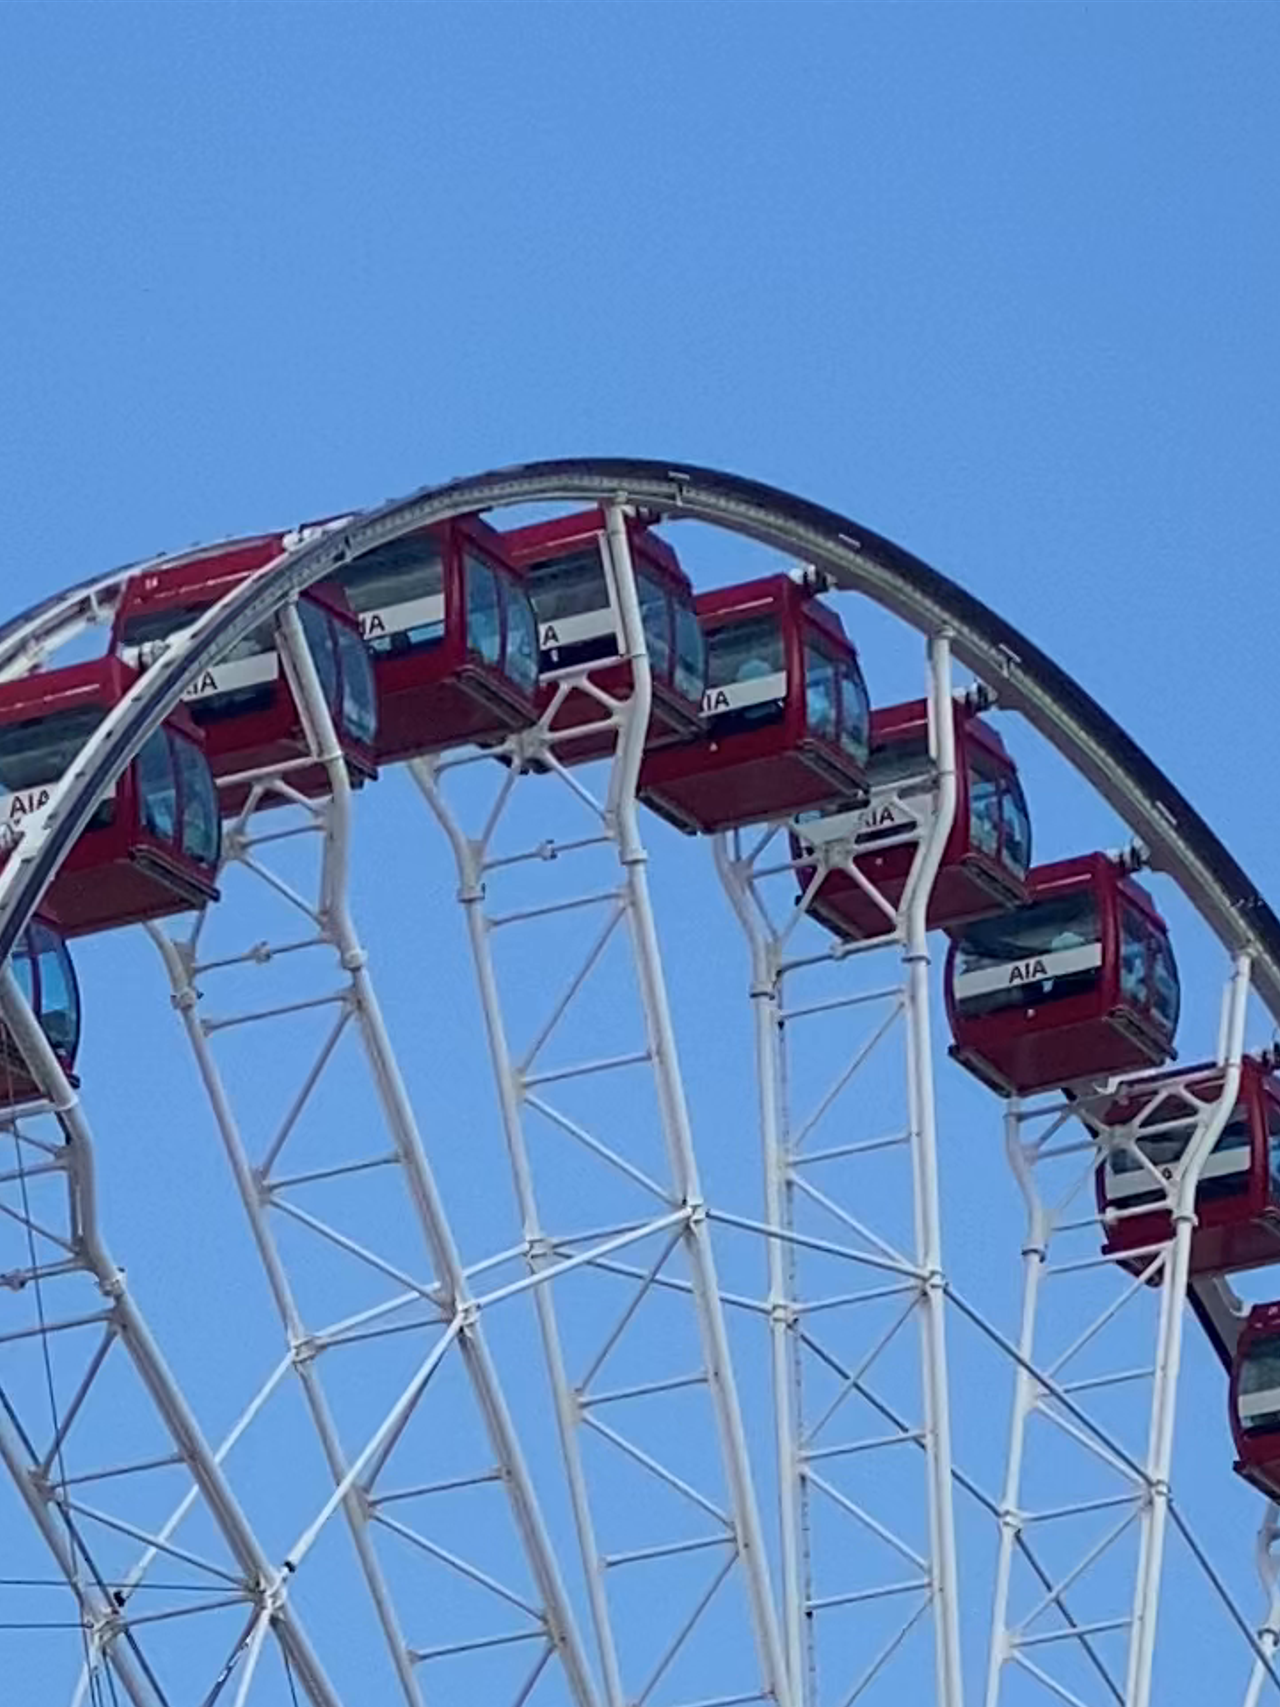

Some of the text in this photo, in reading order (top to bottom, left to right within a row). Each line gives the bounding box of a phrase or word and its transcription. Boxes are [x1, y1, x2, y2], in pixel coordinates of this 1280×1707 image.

[360, 614, 386, 639] IA
[700, 690, 730, 713] IA
[1008, 958, 1048, 984] AIA
